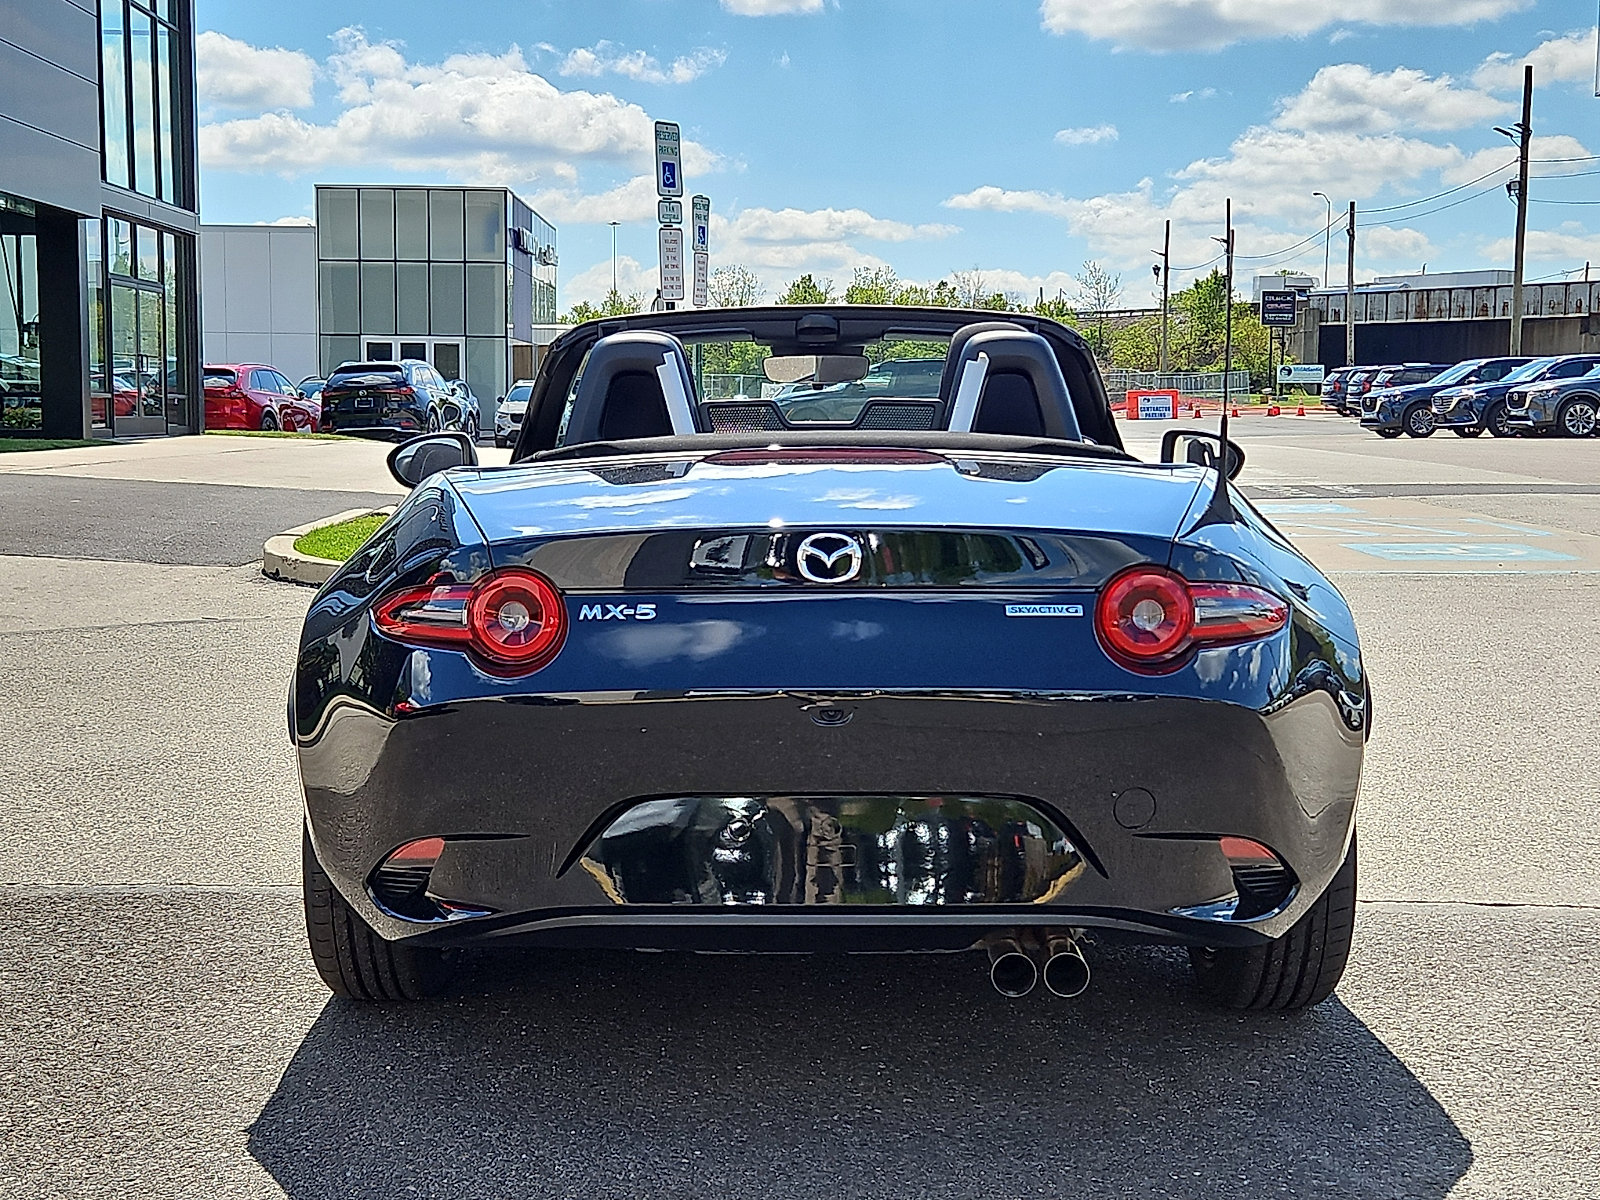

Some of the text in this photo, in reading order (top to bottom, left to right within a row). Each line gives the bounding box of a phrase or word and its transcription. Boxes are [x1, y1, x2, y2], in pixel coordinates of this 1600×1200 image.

[656, 130, 678, 142] RESERVED
[658, 145, 678, 157] PARKING
[578, 603, 657, 620] MX-5
